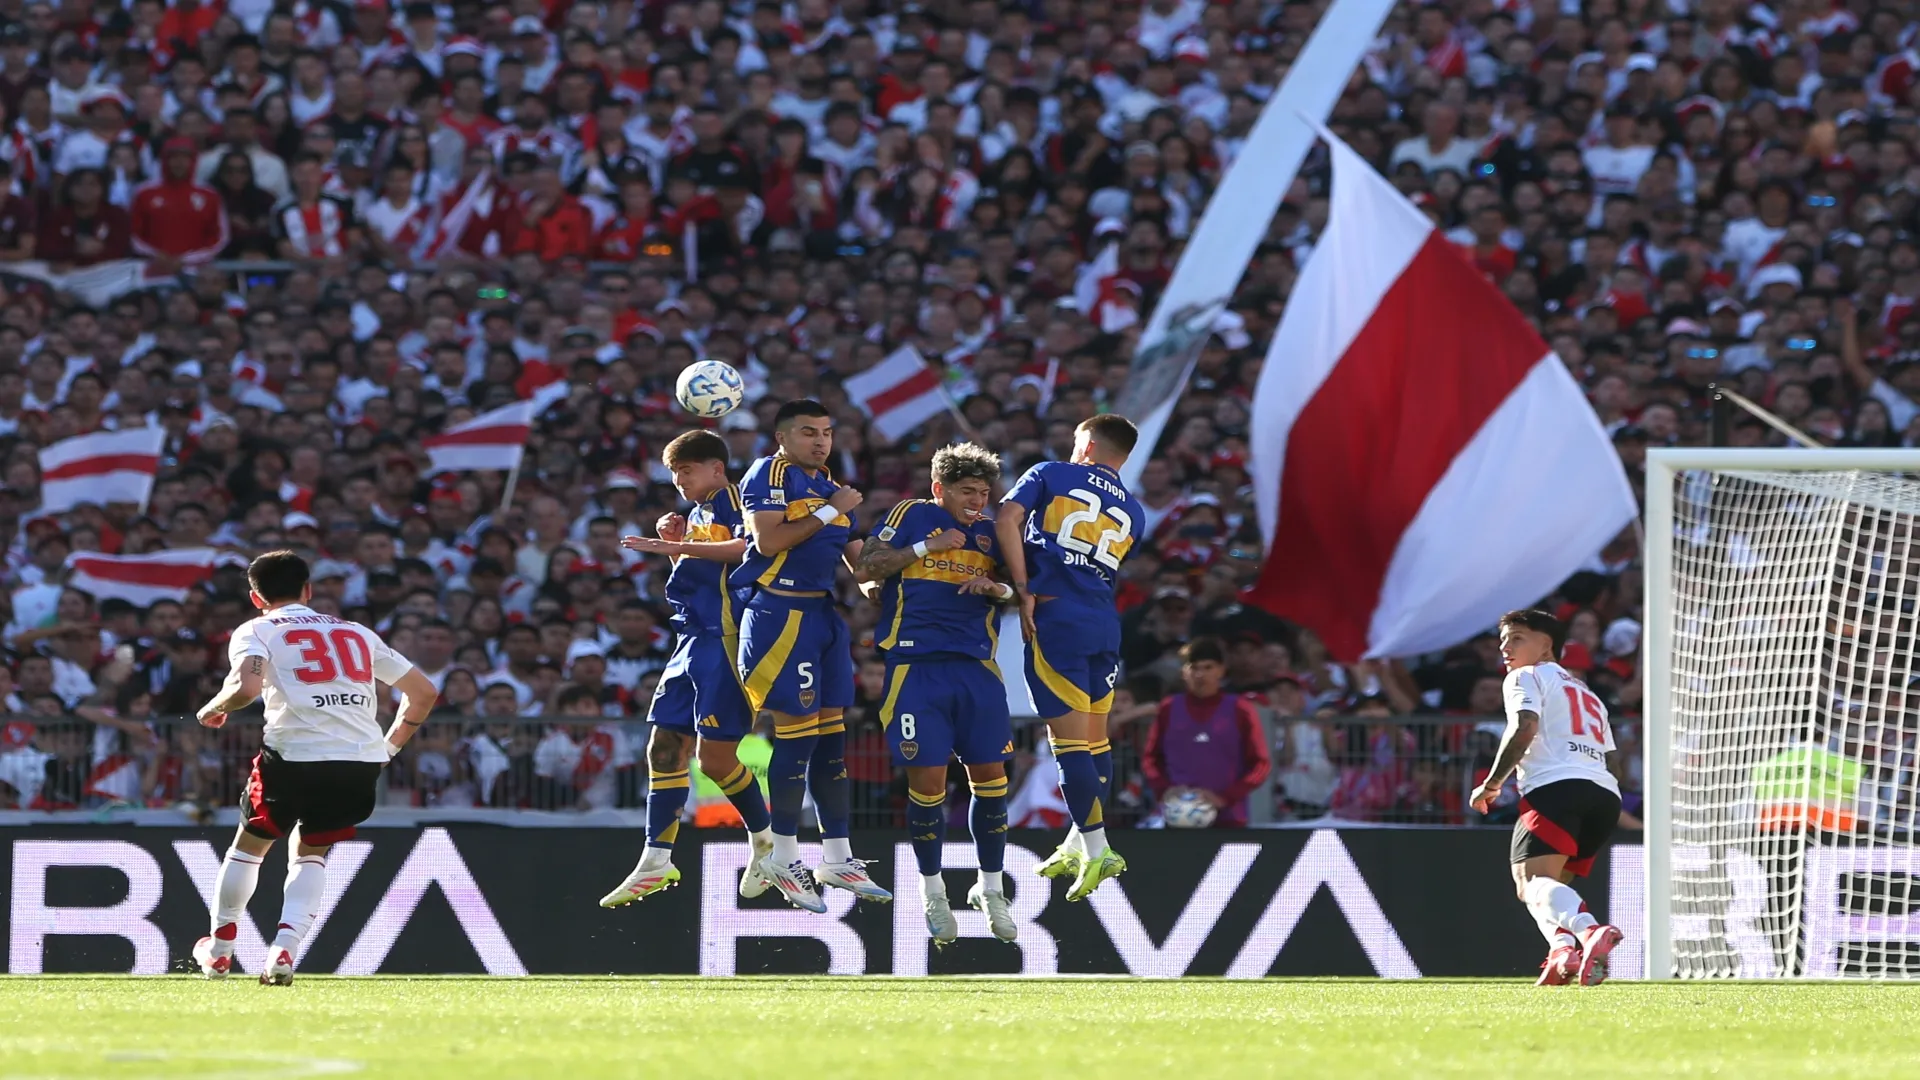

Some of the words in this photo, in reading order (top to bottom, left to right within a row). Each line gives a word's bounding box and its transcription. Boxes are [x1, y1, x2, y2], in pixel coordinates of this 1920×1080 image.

[1088, 472, 1126, 502] ZENON
[1056, 488, 1132, 571] 22
[282, 628, 373, 685] 30
[797, 662, 814, 689] 5
[311, 693, 372, 708] DIRECTV
[1562, 685, 1606, 745] 15
[900, 713, 916, 740] 8
[698, 829, 1422, 979] BBVA
